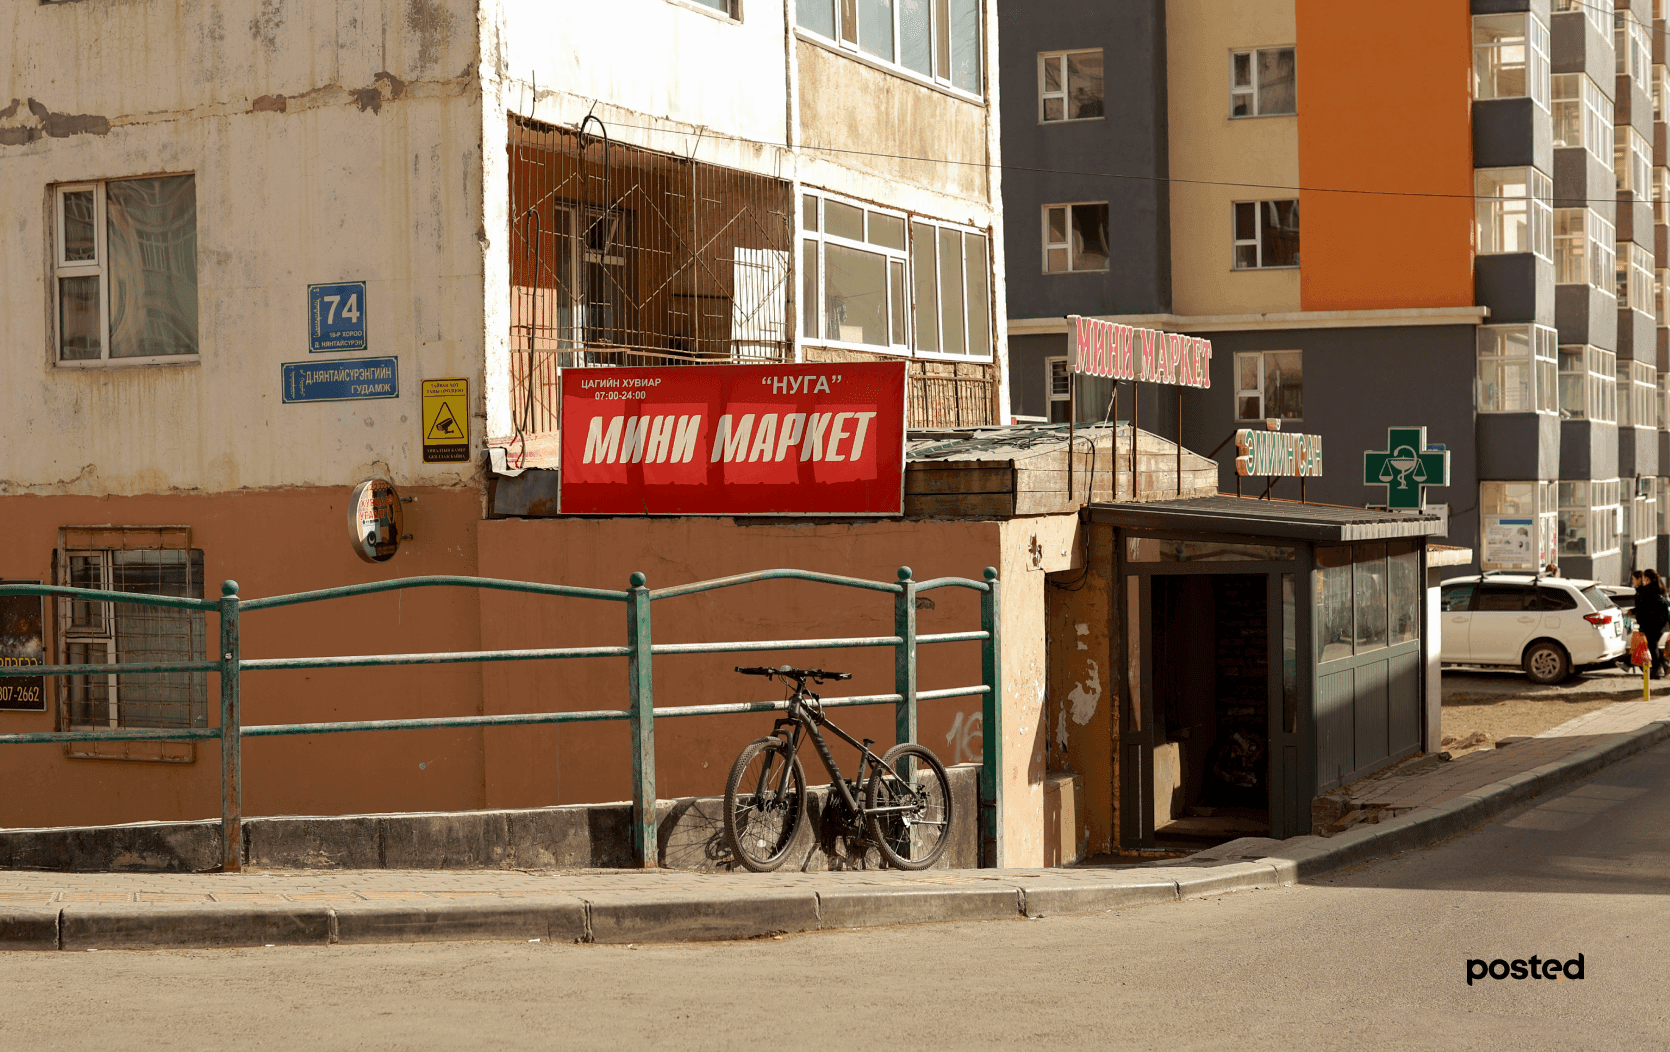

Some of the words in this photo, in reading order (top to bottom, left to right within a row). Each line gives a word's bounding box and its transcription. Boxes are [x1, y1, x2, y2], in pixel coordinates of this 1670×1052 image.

[324, 293, 361, 325] 74
[1075, 314, 1134, 380] МИНИ
[1140, 327, 1213, 389] МАРКЕТ
[351, 383, 391, 395] ГУДАМЖ
[581, 377, 620, 389] ЦАГИЙН
[622, 378, 662, 388] ХУВИАР
[594, 390, 646, 400] 07:00-24:00
[582, 414, 702, 464] МИНИ
[709, 411, 877, 463] МАРКЕТ
[1244, 418, 1296, 477] ЭМИЙН
[1297, 433, 1323, 477] САН
